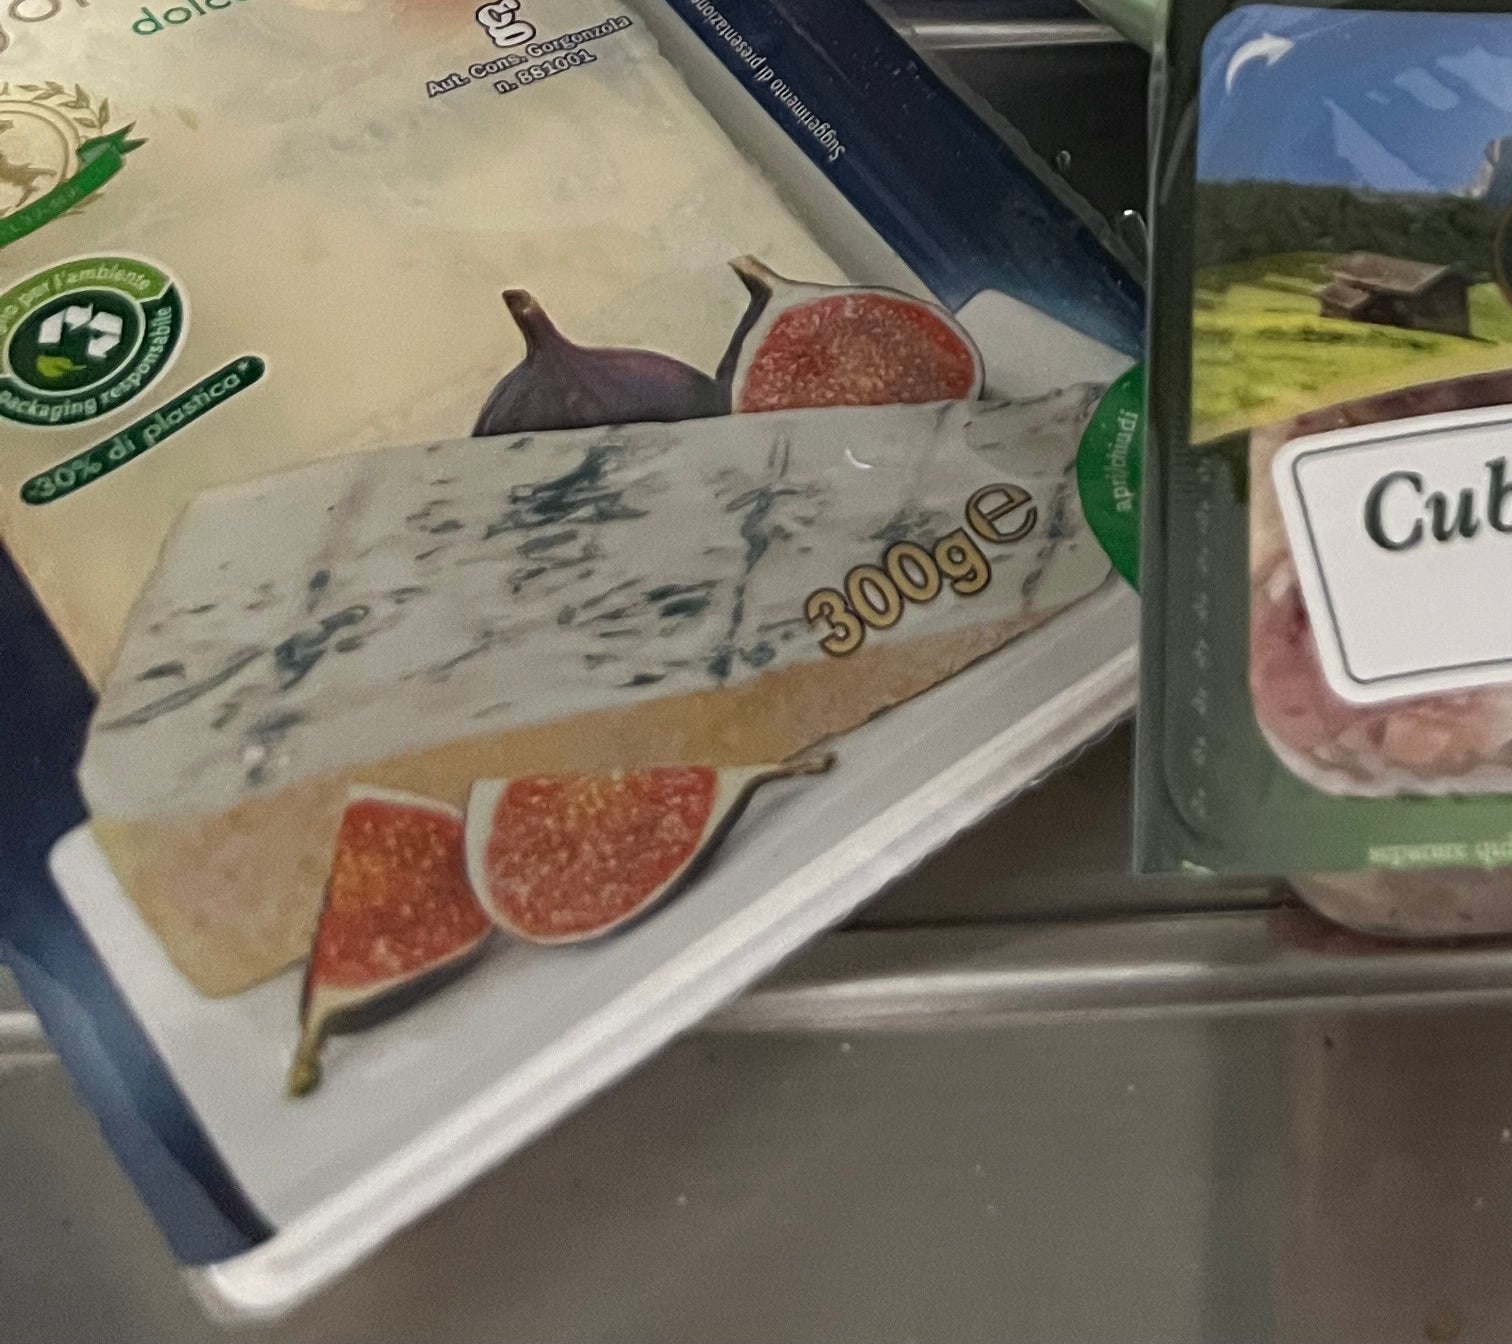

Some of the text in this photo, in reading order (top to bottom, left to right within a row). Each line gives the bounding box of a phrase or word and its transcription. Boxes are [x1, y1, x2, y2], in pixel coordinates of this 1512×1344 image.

[426, 15, 634, 98] Aut. Cons. Gorgonzola
[493, 77, 519, 95] n.
[750, 65, 775, 82] di
[769, 77, 846, 162] Suggerimento
[108, 433, 136, 461] di
